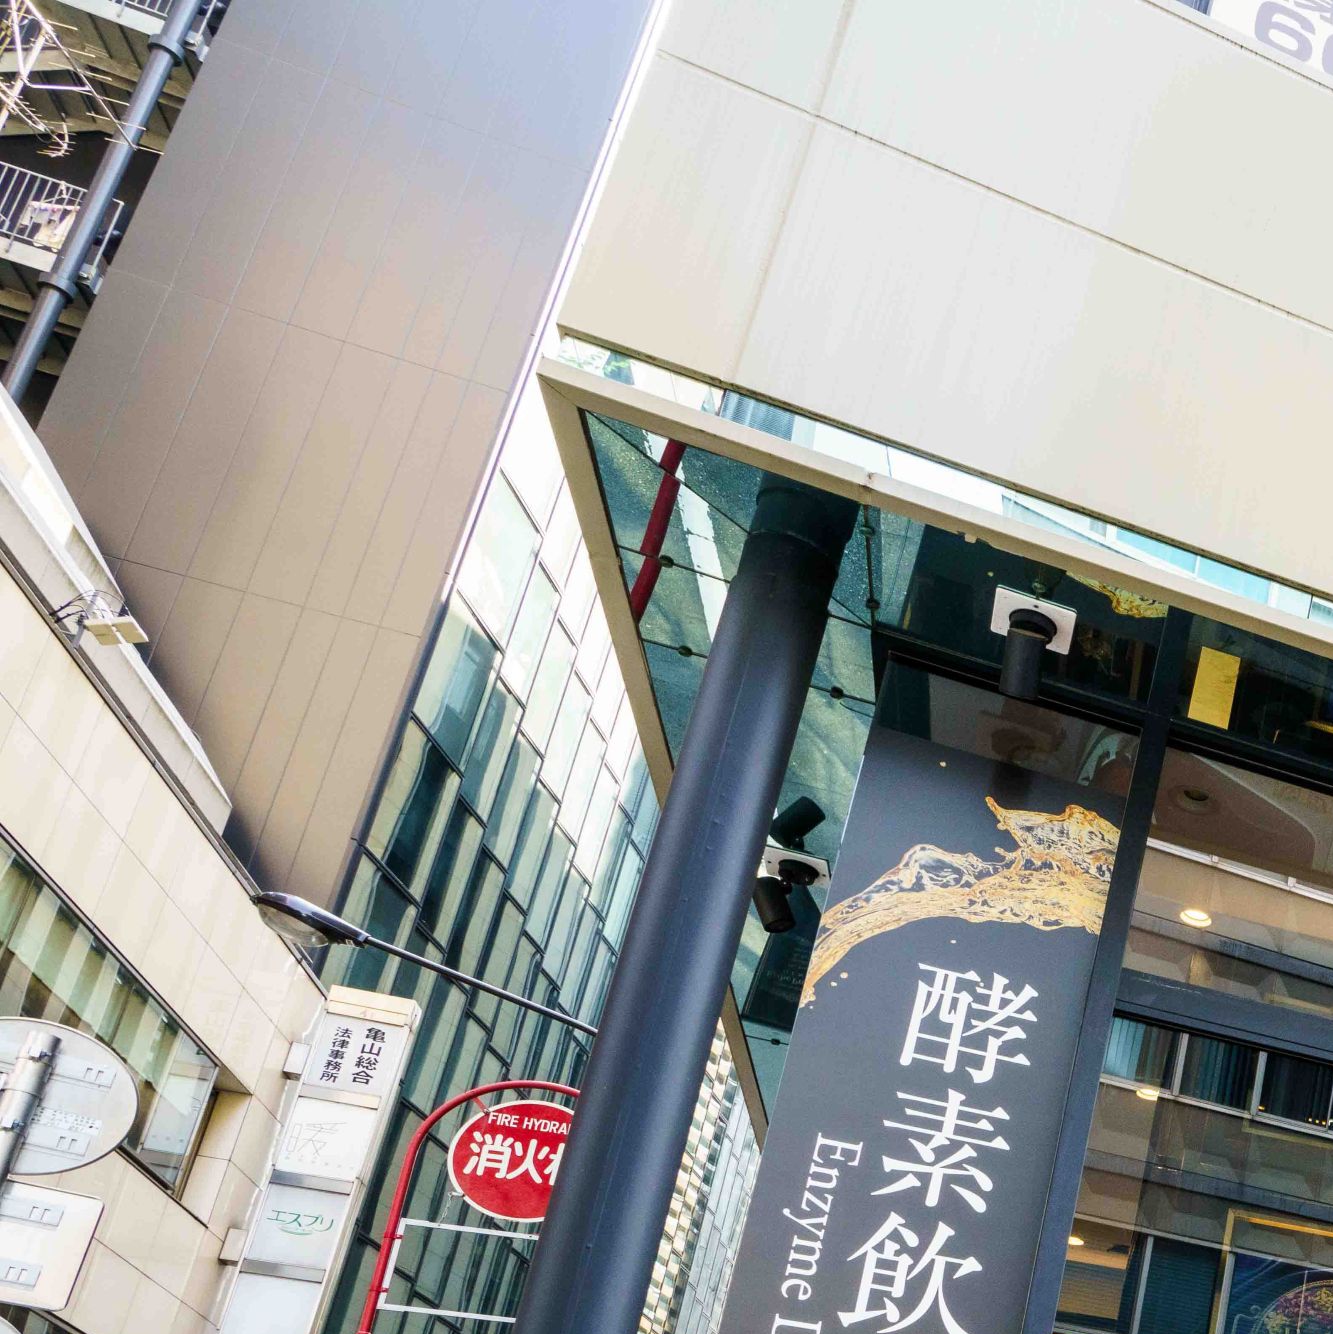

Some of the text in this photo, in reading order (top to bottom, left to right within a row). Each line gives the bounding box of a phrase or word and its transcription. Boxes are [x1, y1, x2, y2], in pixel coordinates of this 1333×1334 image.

[320, 1026, 353, 1083] 法律事務所
[351, 1027, 386, 1085] 亀山総合
[487, 1112, 571, 1135] FIRE HYDRA
[265, 1208, 335, 1234] エスプリ
[777, 1131, 863, 1302] Enzyme
